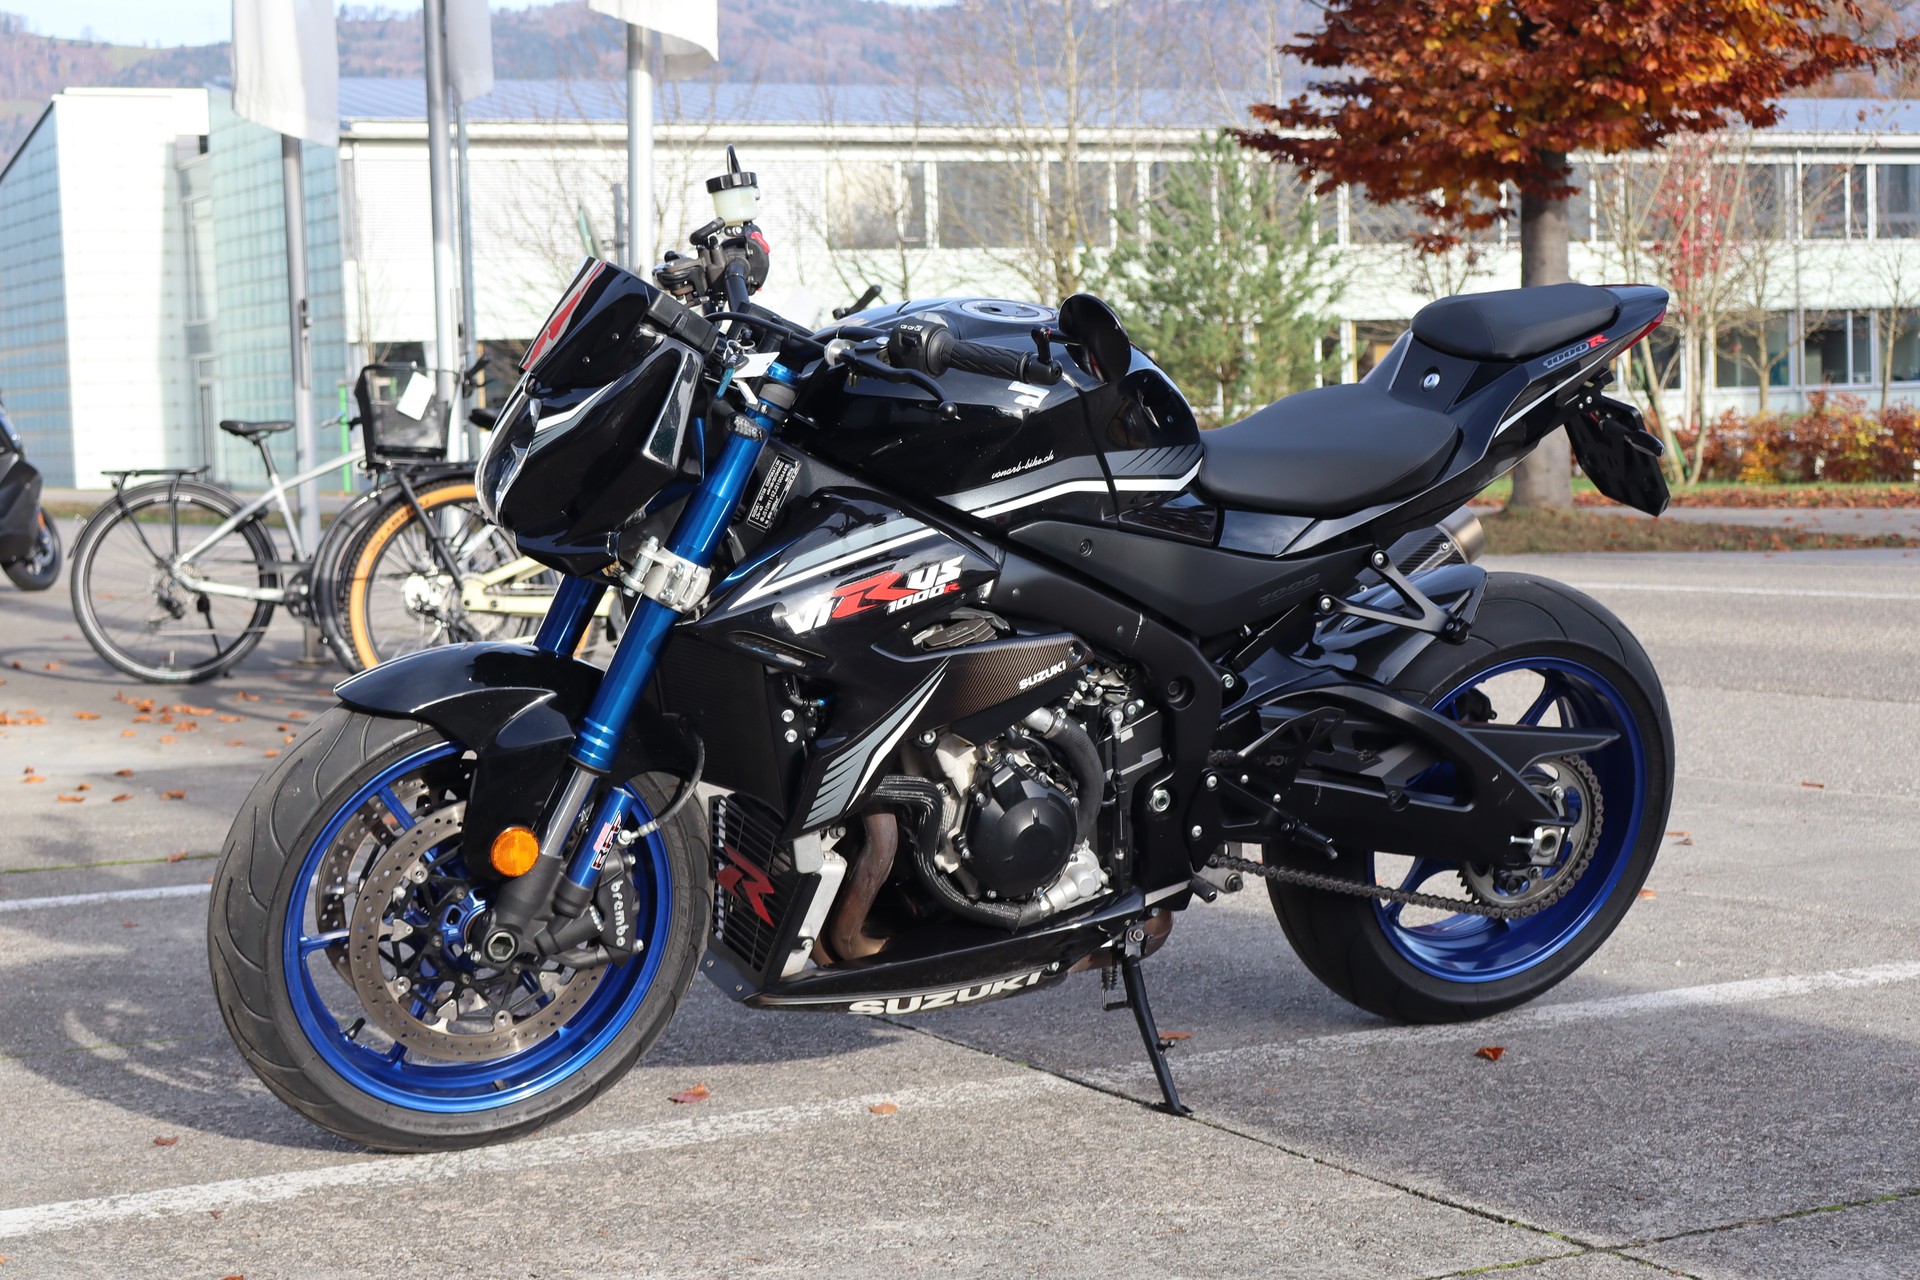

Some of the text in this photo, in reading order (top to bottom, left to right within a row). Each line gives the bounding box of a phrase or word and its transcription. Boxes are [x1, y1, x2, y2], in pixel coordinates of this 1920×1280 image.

[884, 582, 960, 616] 1000R
[1018, 660, 1067, 690] SUZUKI
[610, 879, 630, 948] brembo
[666, 822, 692, 964] MICHELIN
[848, 970, 1042, 1016] SUZUKI
